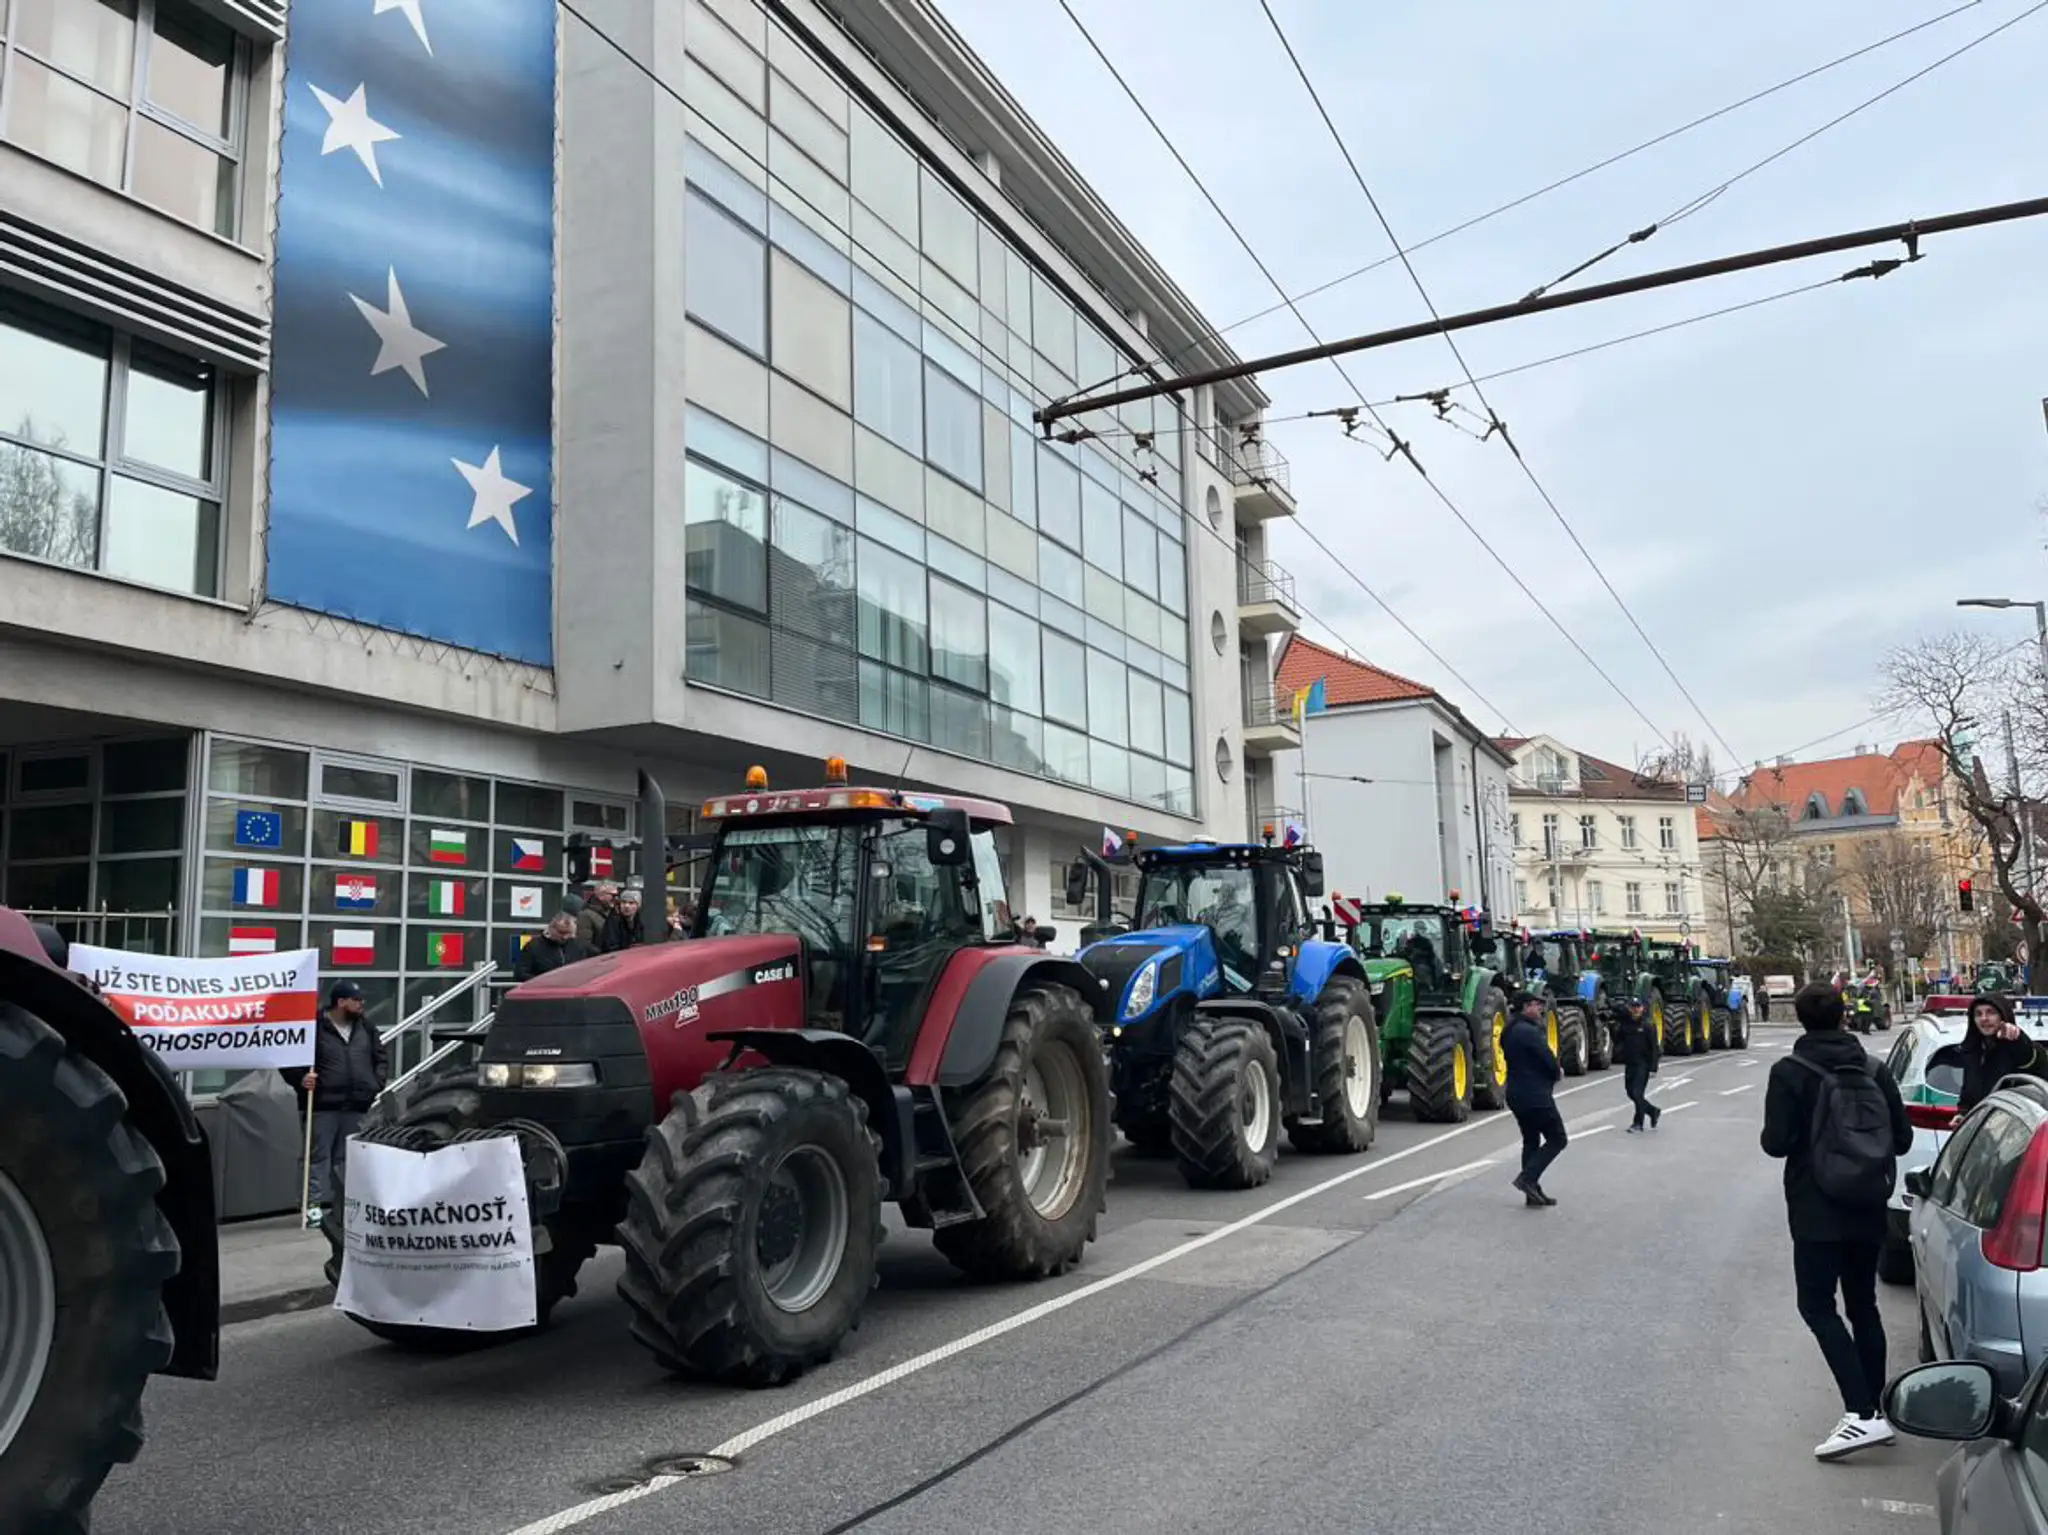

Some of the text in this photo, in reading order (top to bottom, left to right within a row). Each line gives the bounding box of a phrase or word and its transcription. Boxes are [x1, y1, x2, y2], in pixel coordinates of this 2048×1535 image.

[95, 966, 297, 994] UŽ STE DNES JEDLI?
[755, 967, 783, 984] CASE
[134, 1001, 266, 1022] POĎAKUJTE
[140, 1025, 306, 1051] OHOSPODÁROM
[365, 1196, 514, 1227] SEBESTAČNOSŤ,
[365, 1227, 517, 1250] NIE PRÁZDNE SLOVÁ
